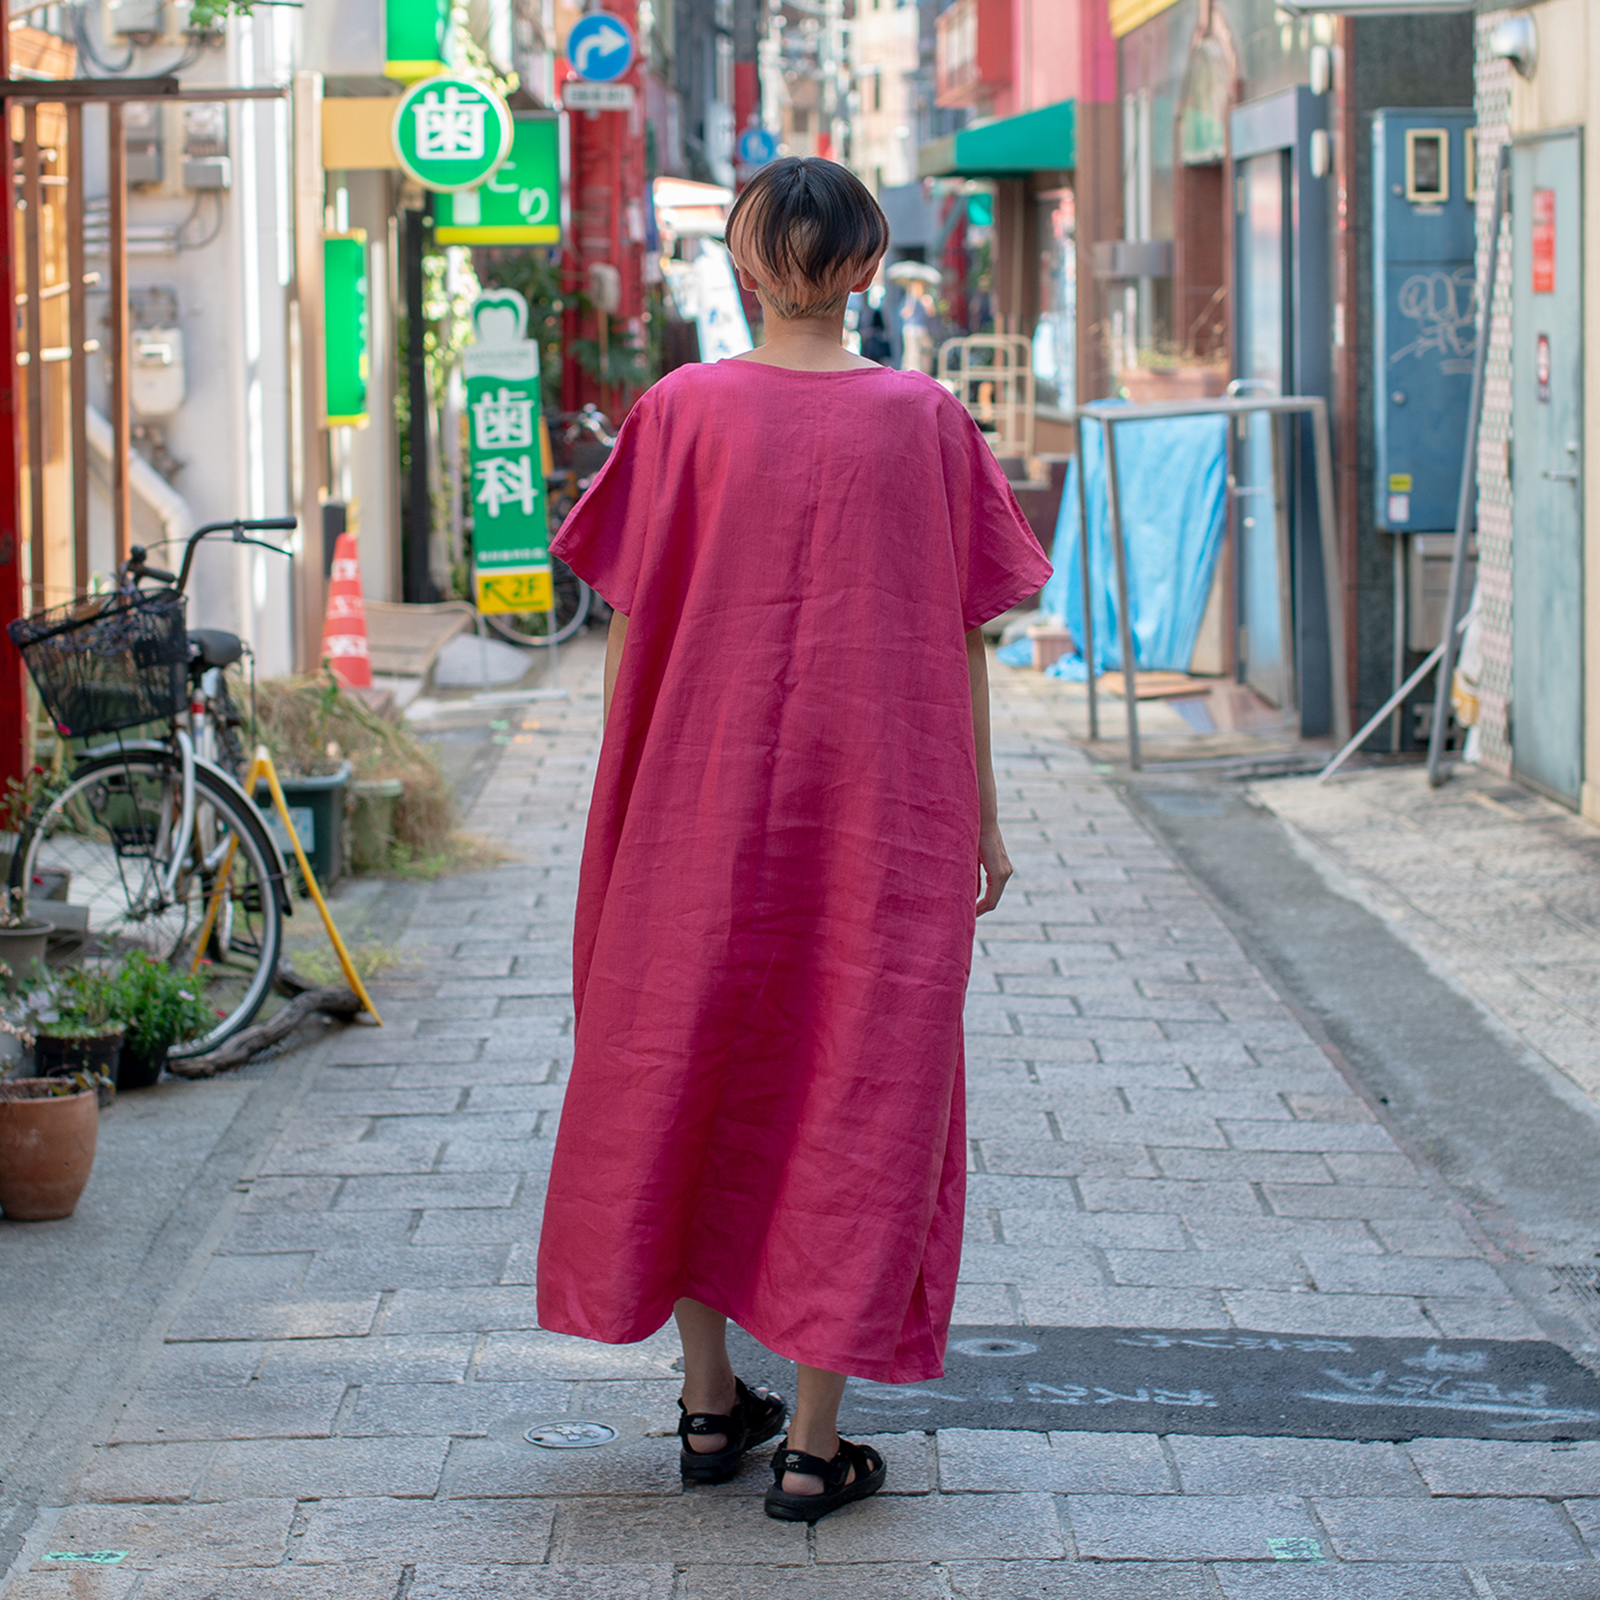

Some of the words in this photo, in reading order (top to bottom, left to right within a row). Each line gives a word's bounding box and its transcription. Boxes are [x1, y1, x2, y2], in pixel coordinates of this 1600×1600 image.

[411, 87, 489, 160] 歯
[471, 387, 539, 518] 歯科
[512, 577, 539, 597] 2F
